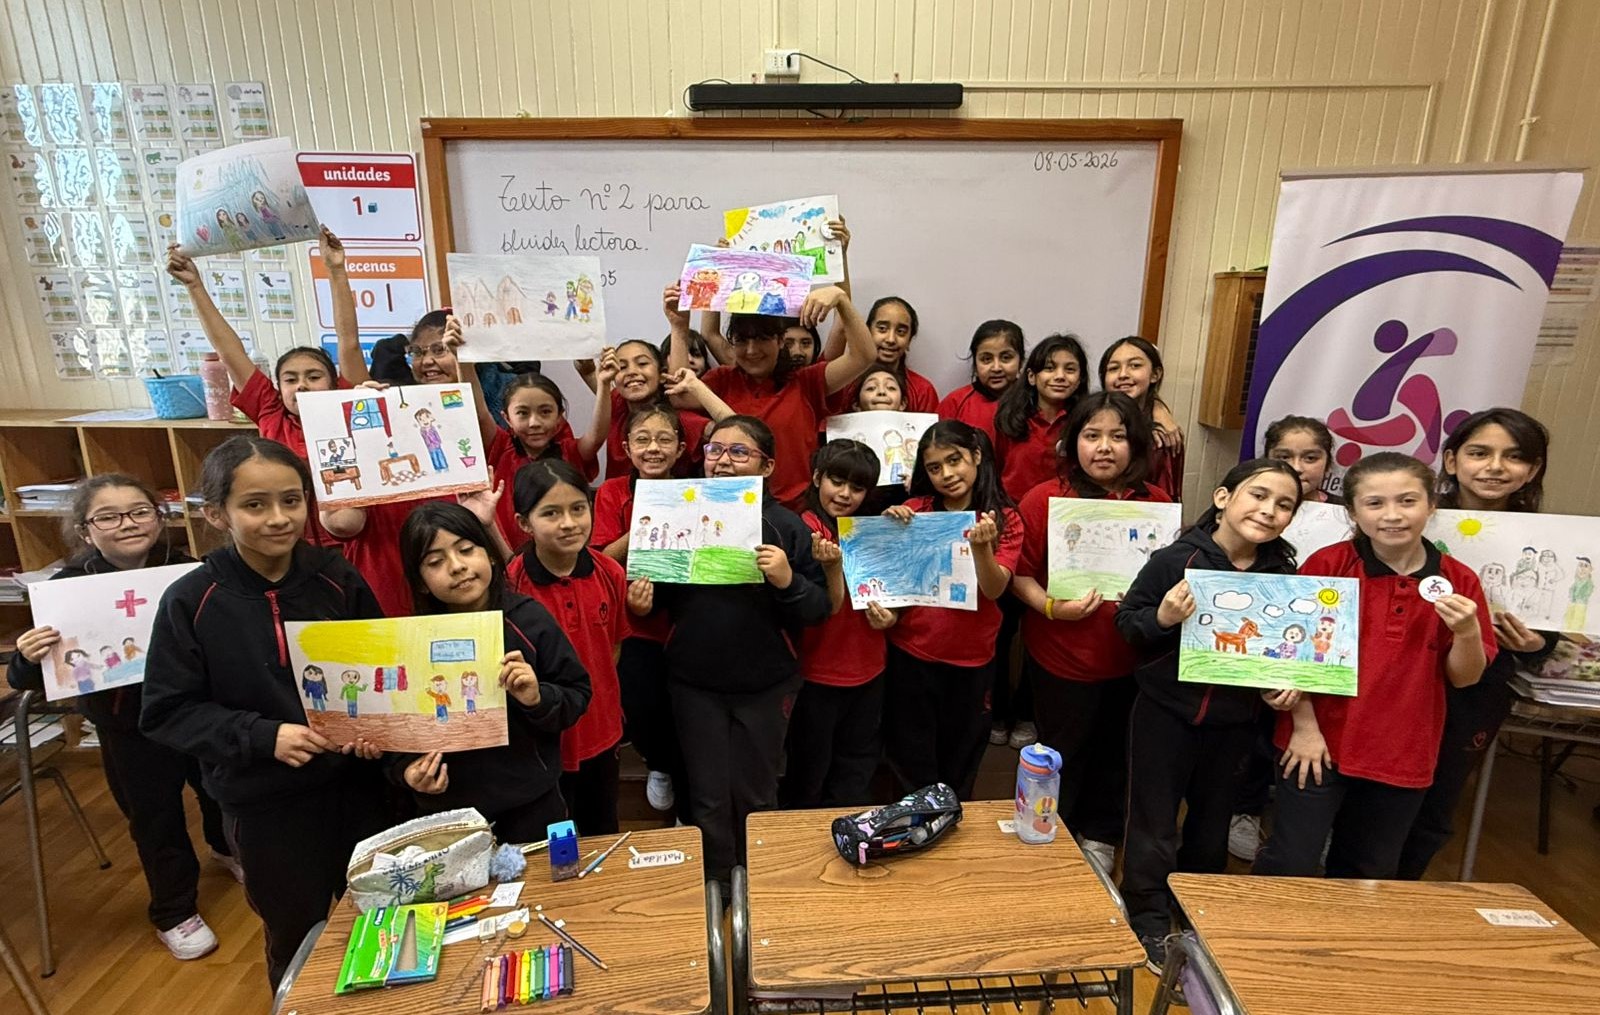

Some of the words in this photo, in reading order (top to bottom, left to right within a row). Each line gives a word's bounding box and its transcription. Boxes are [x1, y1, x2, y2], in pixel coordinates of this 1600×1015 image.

[323, 166, 391, 181] unidades
[352, 196, 362, 215] 1
[498, 175, 570, 212] Texto
[619, 184, 634, 209] 2
[643, 193, 711, 232] para
[575, 224, 648, 251] lectora.
